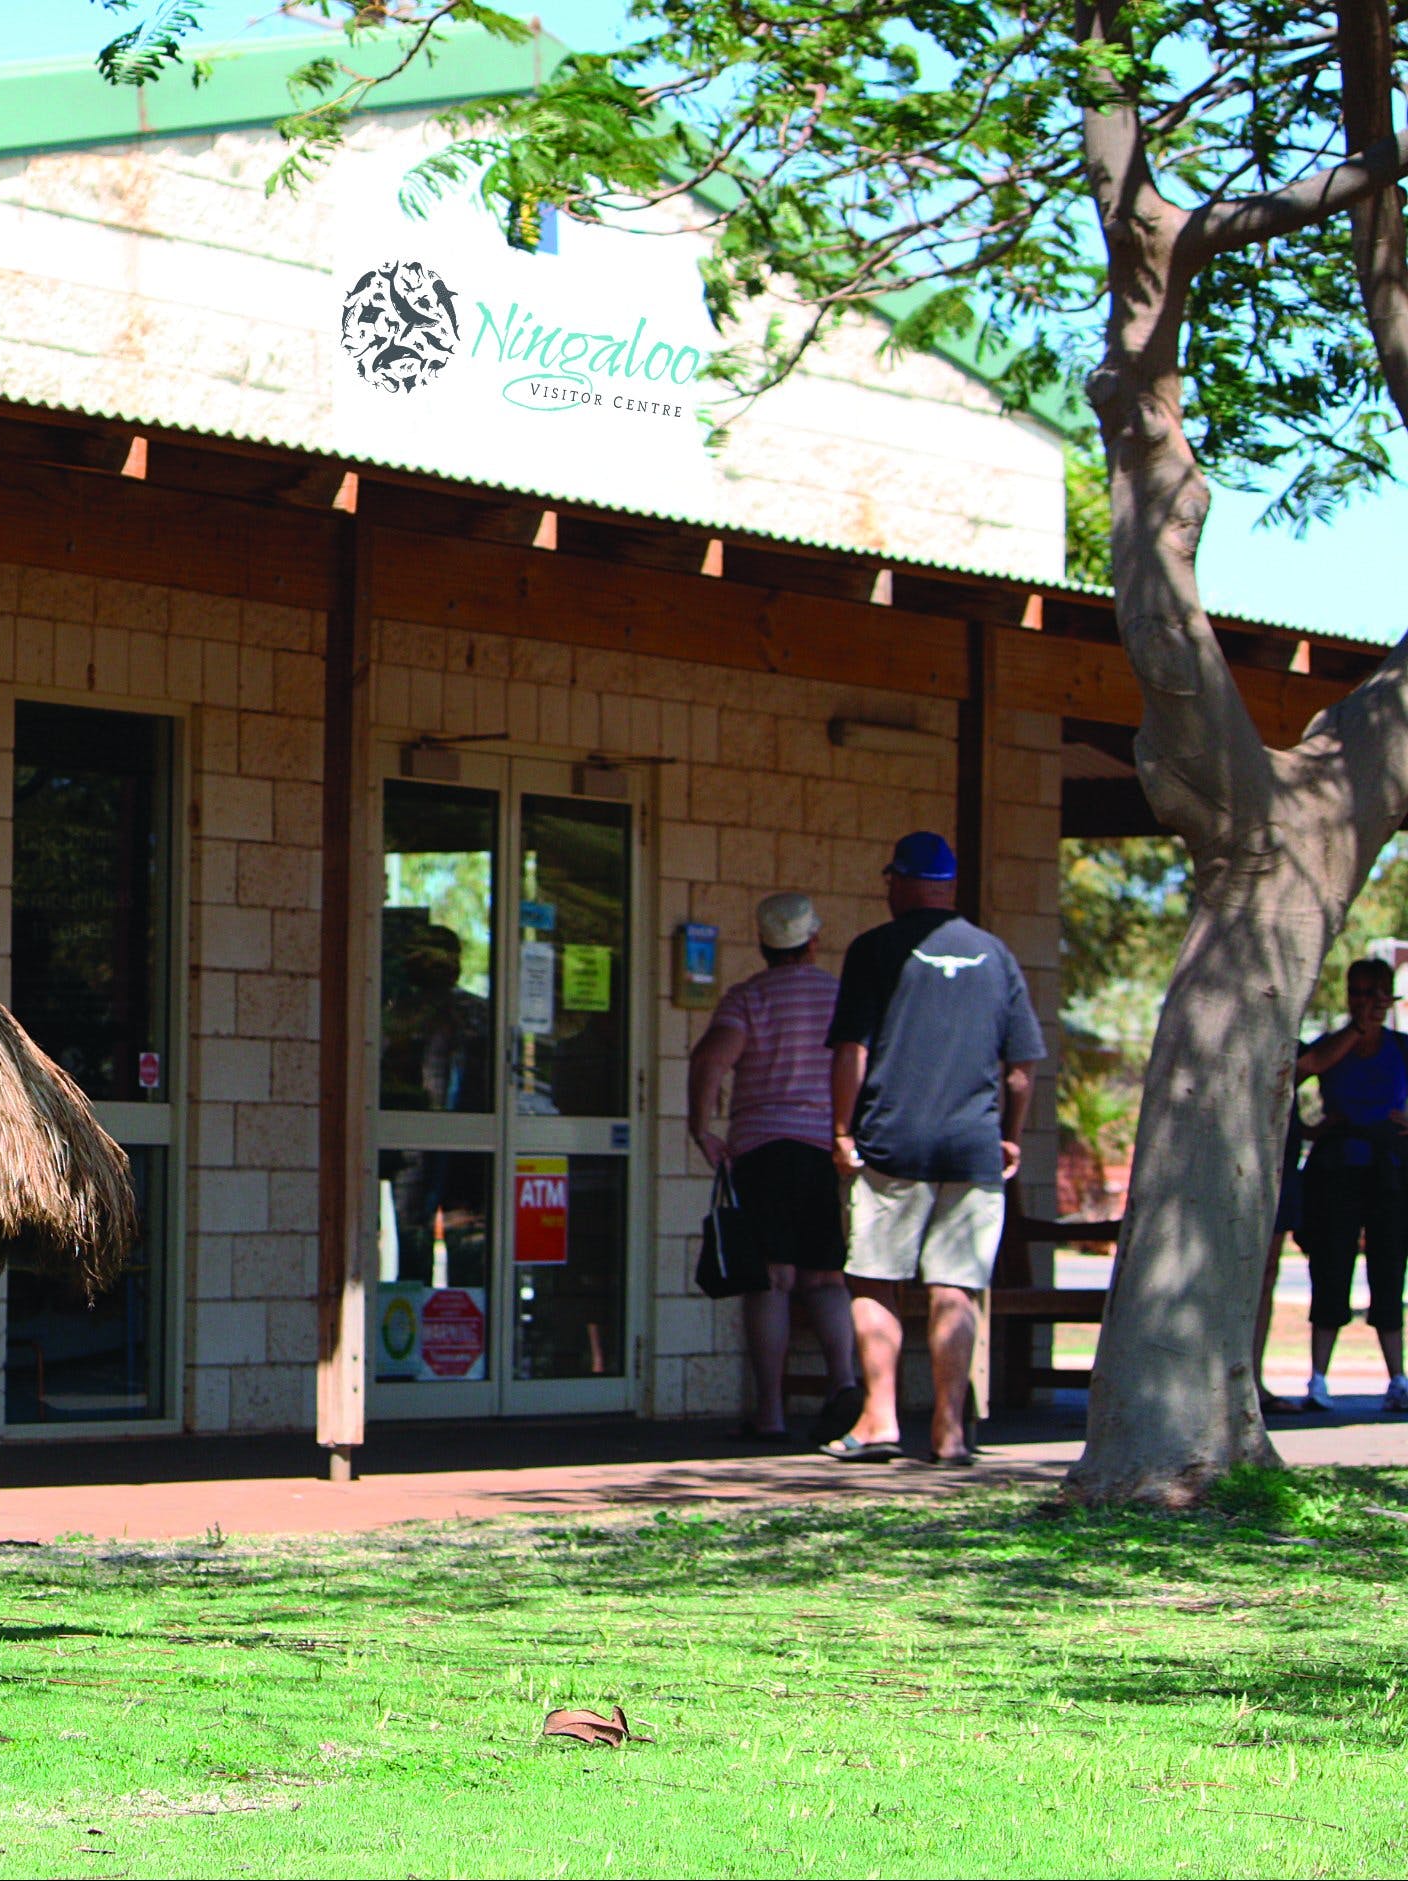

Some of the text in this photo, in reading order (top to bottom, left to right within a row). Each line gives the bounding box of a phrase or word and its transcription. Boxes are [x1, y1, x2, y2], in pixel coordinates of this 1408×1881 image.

[471, 302, 701, 387] Ningaloo
[529, 382, 683, 418] VISITOR CENTRE
[519, 1178, 568, 1208] ATM
